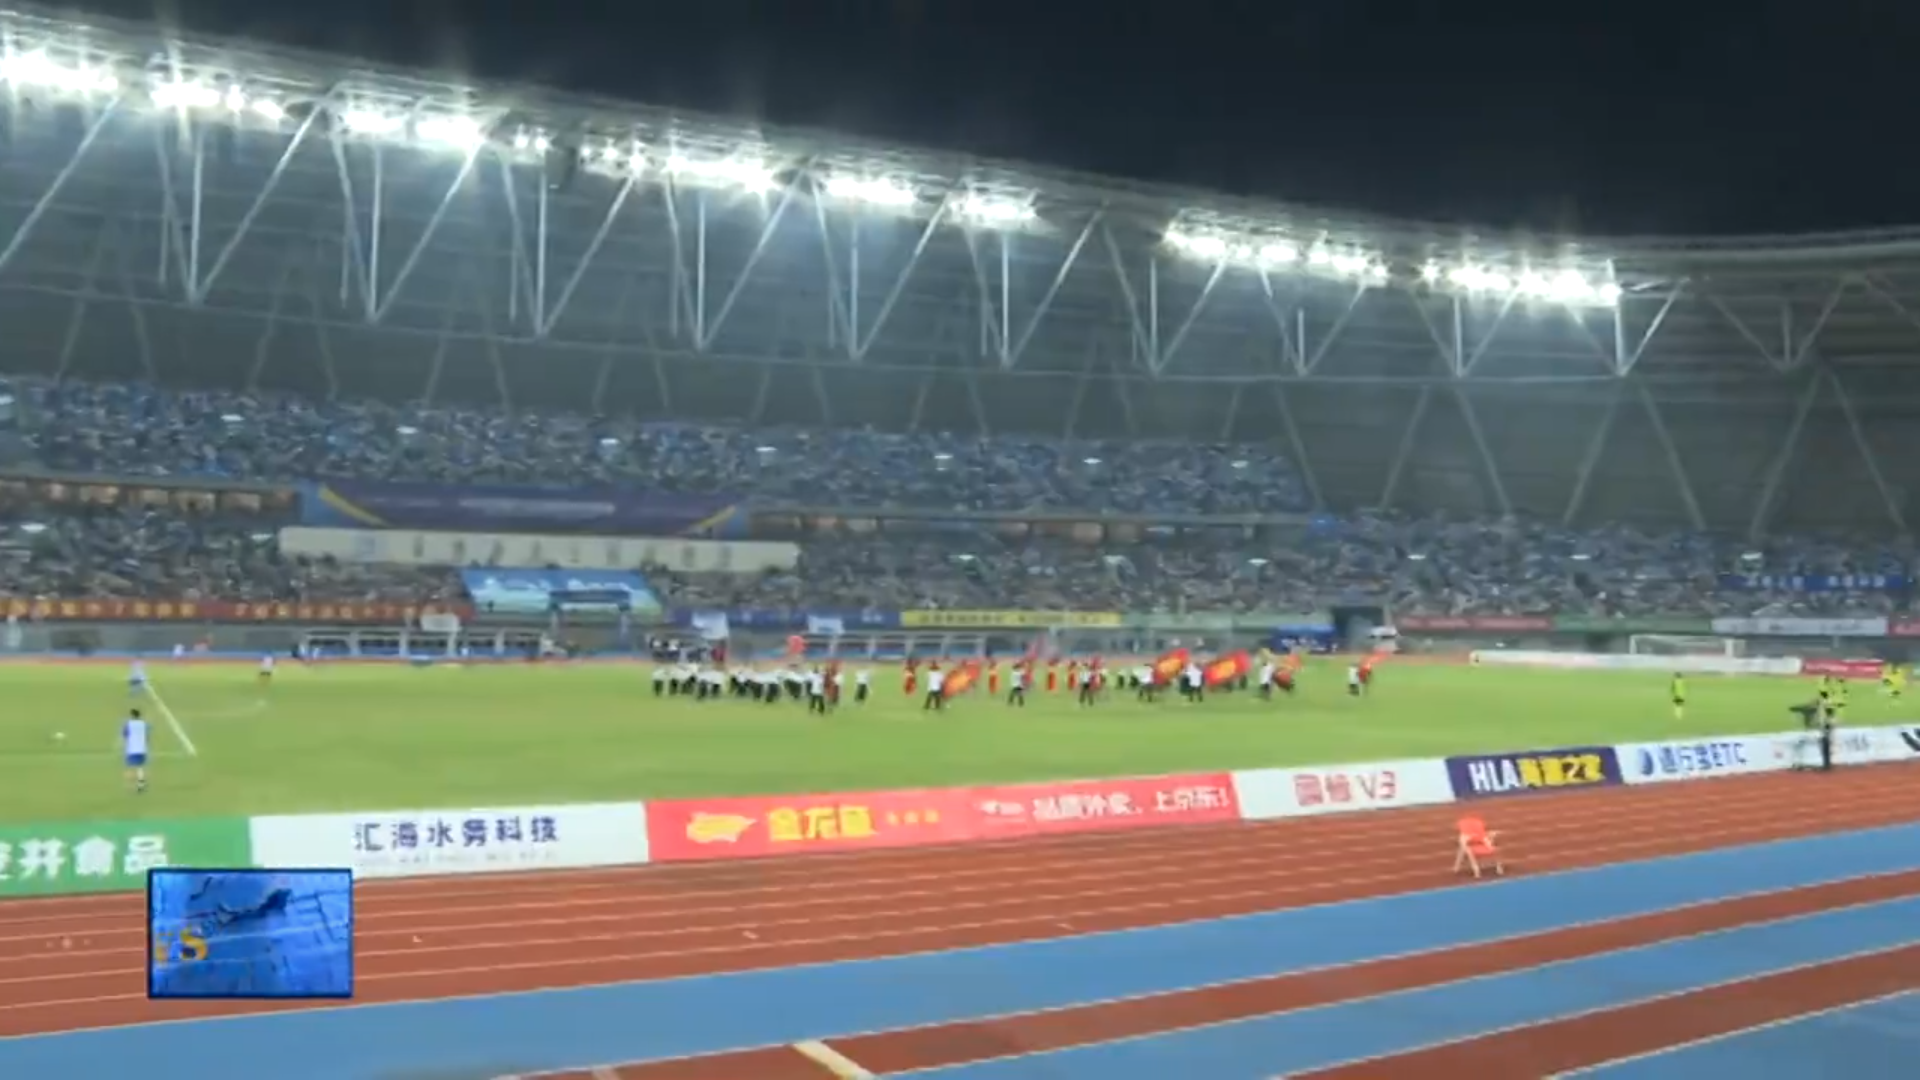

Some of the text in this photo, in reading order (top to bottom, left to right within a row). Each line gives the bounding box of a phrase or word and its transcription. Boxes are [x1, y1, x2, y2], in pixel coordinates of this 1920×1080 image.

[354, 816, 558, 851] 汇海水务科技
